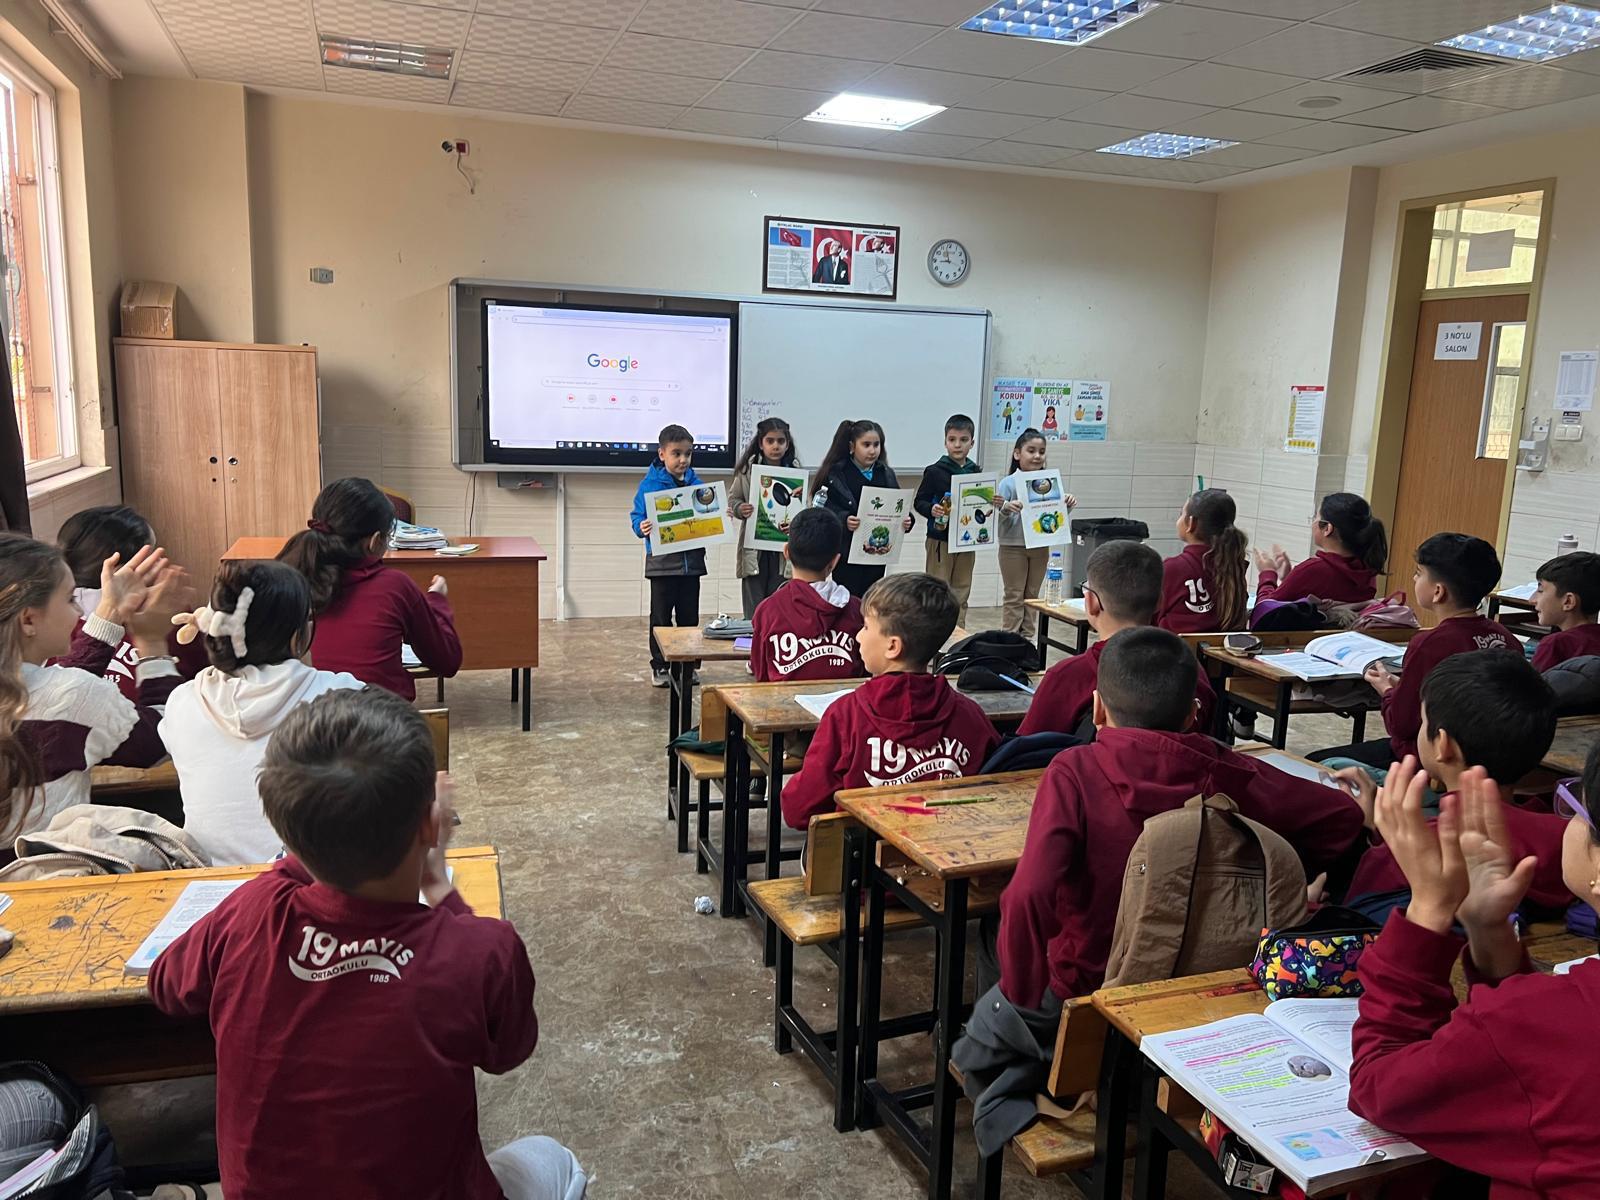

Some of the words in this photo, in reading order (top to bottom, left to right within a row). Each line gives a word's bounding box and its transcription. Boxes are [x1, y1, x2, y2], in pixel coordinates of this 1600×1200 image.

[587, 353, 638, 373] Google
[1185, 578, 1210, 603] 19
[769, 632, 798, 662] 19
[798, 630, 854, 651] MAYIS
[1472, 636, 1488, 648] 19
[783, 647, 833, 672] ORTAOKULU
[867, 737, 906, 774] 19
[907, 737, 971, 766] MAYIS
[297, 925, 338, 966] 19
[340, 938, 414, 966] MAYIS
[310, 959, 368, 980] ORTAOKULU
